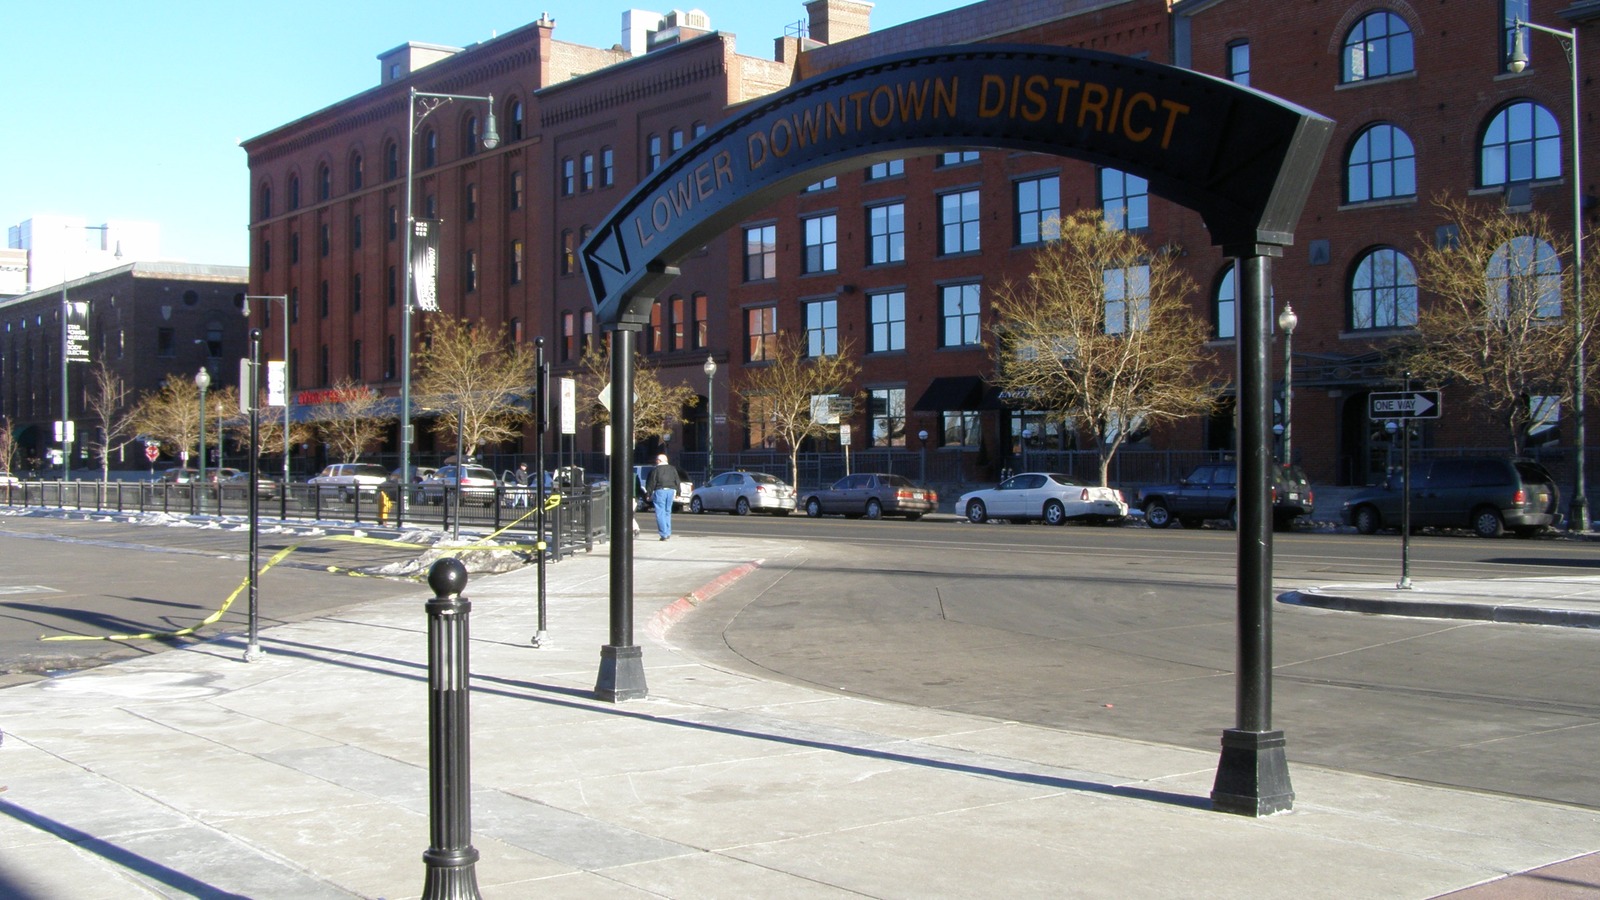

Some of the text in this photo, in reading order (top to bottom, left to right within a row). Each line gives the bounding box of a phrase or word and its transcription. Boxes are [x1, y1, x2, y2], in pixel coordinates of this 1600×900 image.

[635, 74, 1191, 249] LOWER DOWNTOWN DISTRICT
[1375, 400, 1416, 410] ONE WAY
